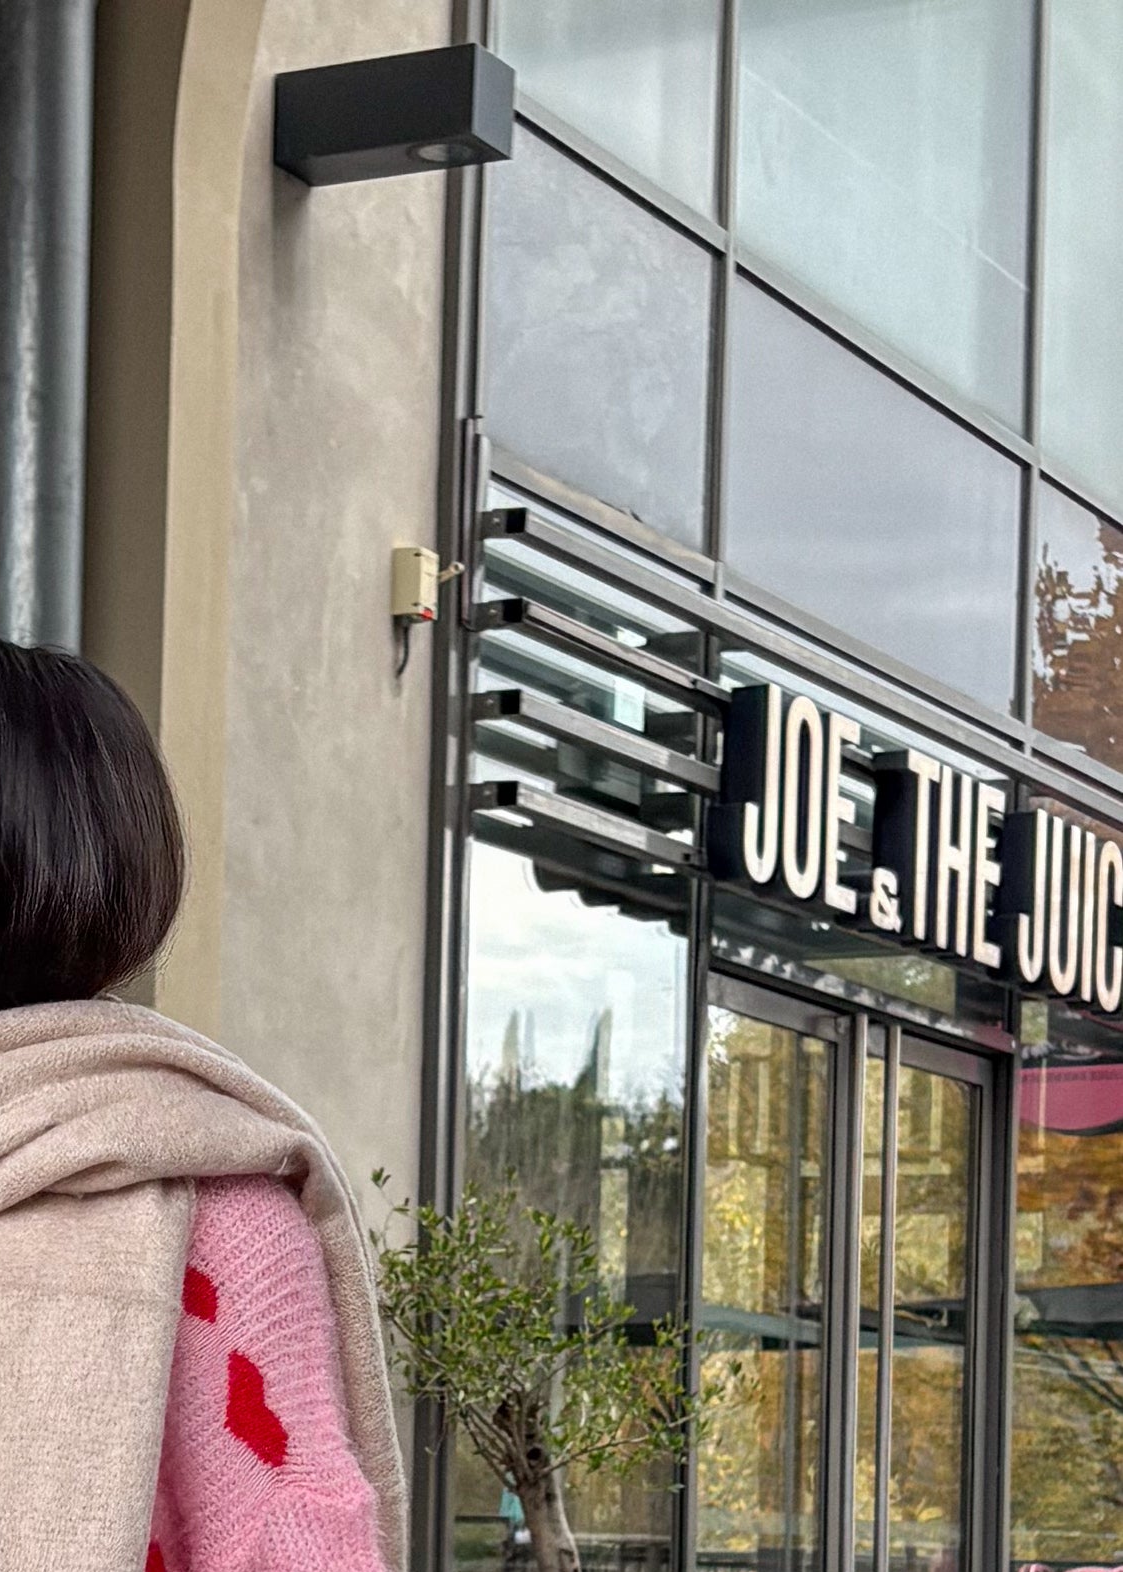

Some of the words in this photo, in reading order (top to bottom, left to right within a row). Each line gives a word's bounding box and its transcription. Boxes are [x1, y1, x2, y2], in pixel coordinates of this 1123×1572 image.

[743, 683, 861, 914] JOE
[870, 867, 901, 933] &
[908, 749, 1006, 969] THE
